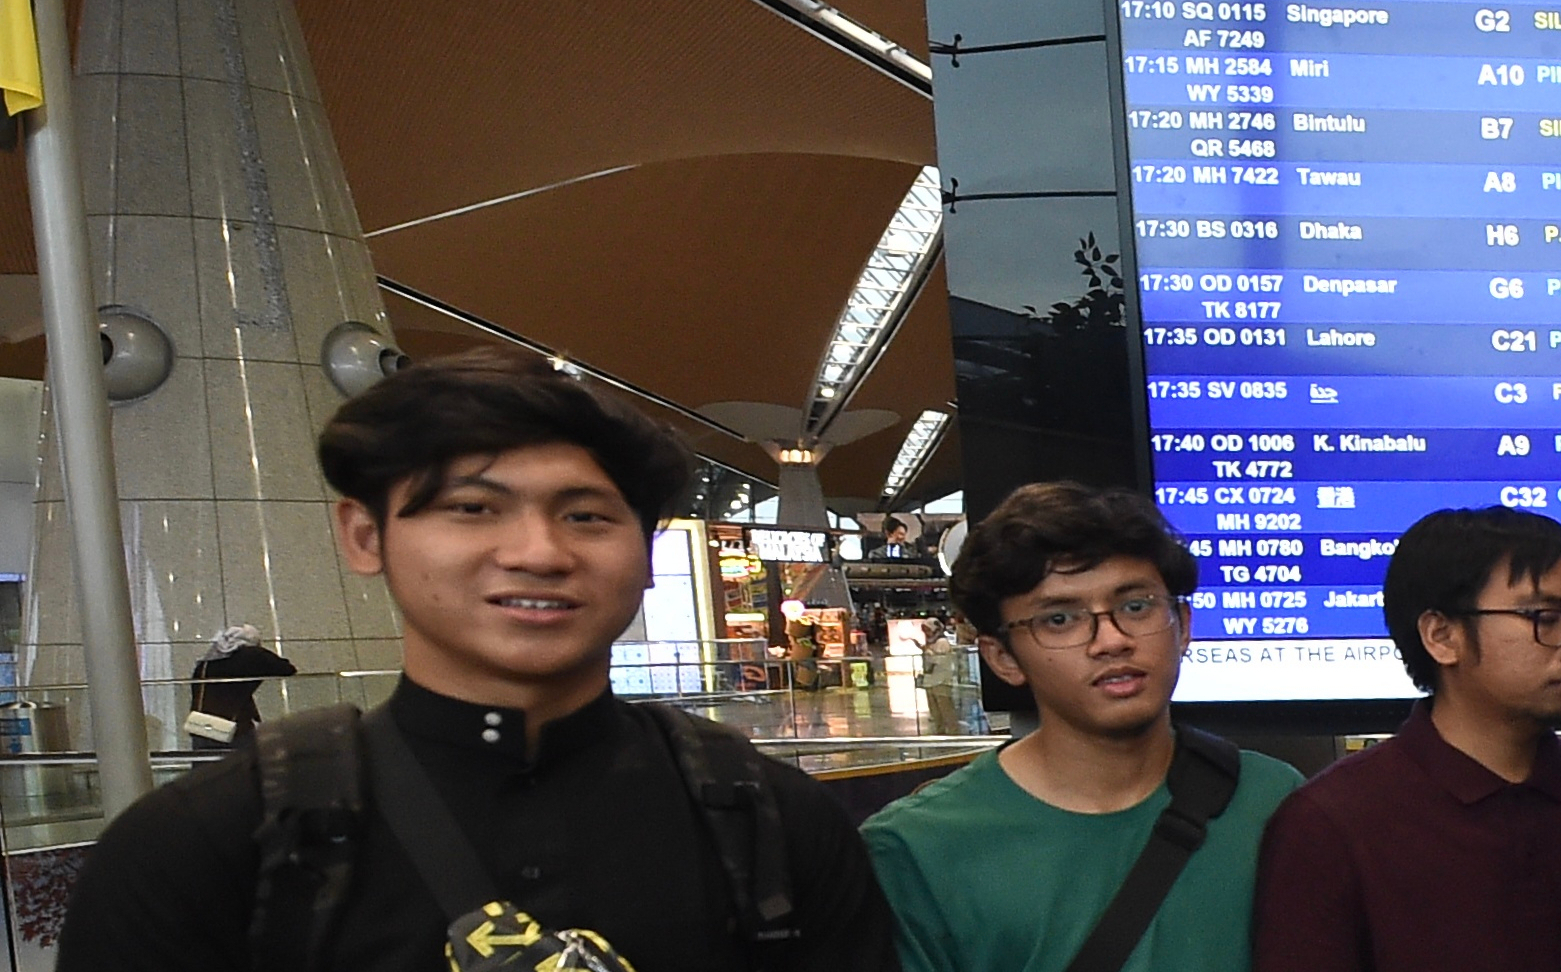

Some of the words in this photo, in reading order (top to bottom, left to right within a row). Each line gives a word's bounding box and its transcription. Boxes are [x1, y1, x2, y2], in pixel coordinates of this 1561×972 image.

[1122, 1, 1175, 18] 17:10
[1182, 2, 1213, 20] SQ
[1218, 3, 1265, 20] 0115
[1288, 5, 1388, 27] Singapore
[1475, 10, 1510, 31] G2
[1125, 56, 1179, 73] 17:15
[1186, 57, 1219, 74] MH
[1225, 58, 1272, 75] 2584
[1291, 60, 1329, 77] Miri
[1478, 64, 1524, 85] A10
[1300, 222, 1362, 239] Dhaka
[1487, 225, 1519, 245] H6
[1148, 382, 1201, 398] 17:35
[1208, 382, 1235, 398] SV
[1240, 382, 1287, 398] 0835
[1495, 383, 1527, 403] C3
[1156, 488, 1208, 504] 17:45
[1215, 487, 1244, 504] CX
[1249, 487, 1295, 504] 0724
[1501, 487, 1547, 507] C32
[1261, 648, 1285, 662] AT
[1299, 647, 1335, 662] THE
